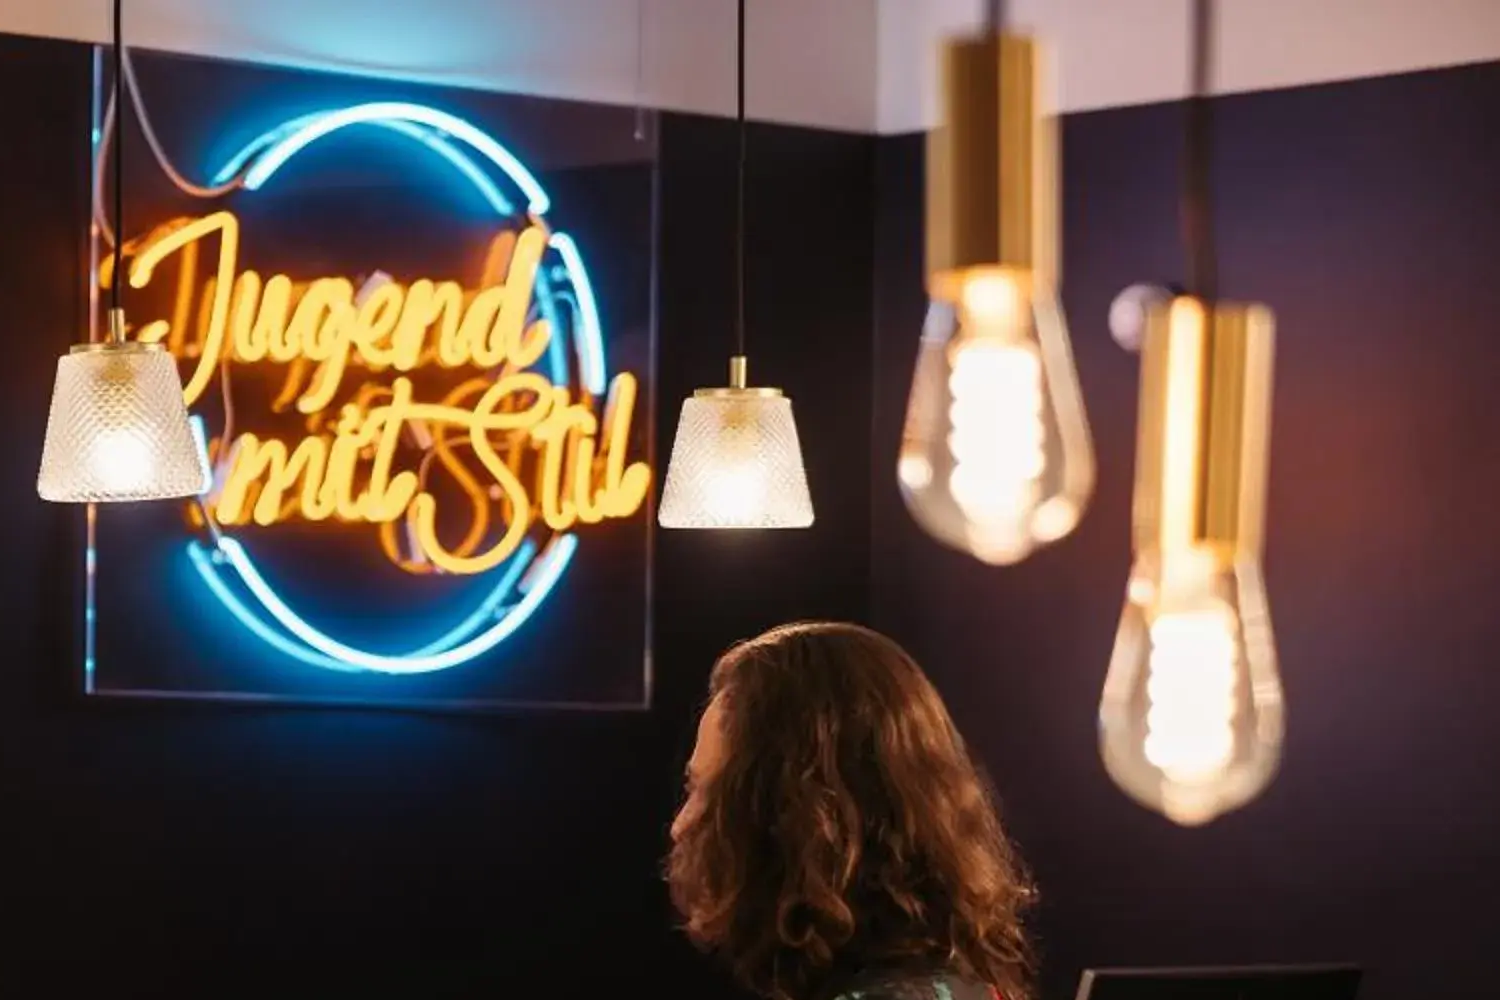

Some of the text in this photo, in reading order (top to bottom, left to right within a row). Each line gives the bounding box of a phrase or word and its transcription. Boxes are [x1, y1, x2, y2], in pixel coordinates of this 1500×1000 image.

[129, 211, 551, 413] Jugend
[216, 371, 651, 575] mit Stil
